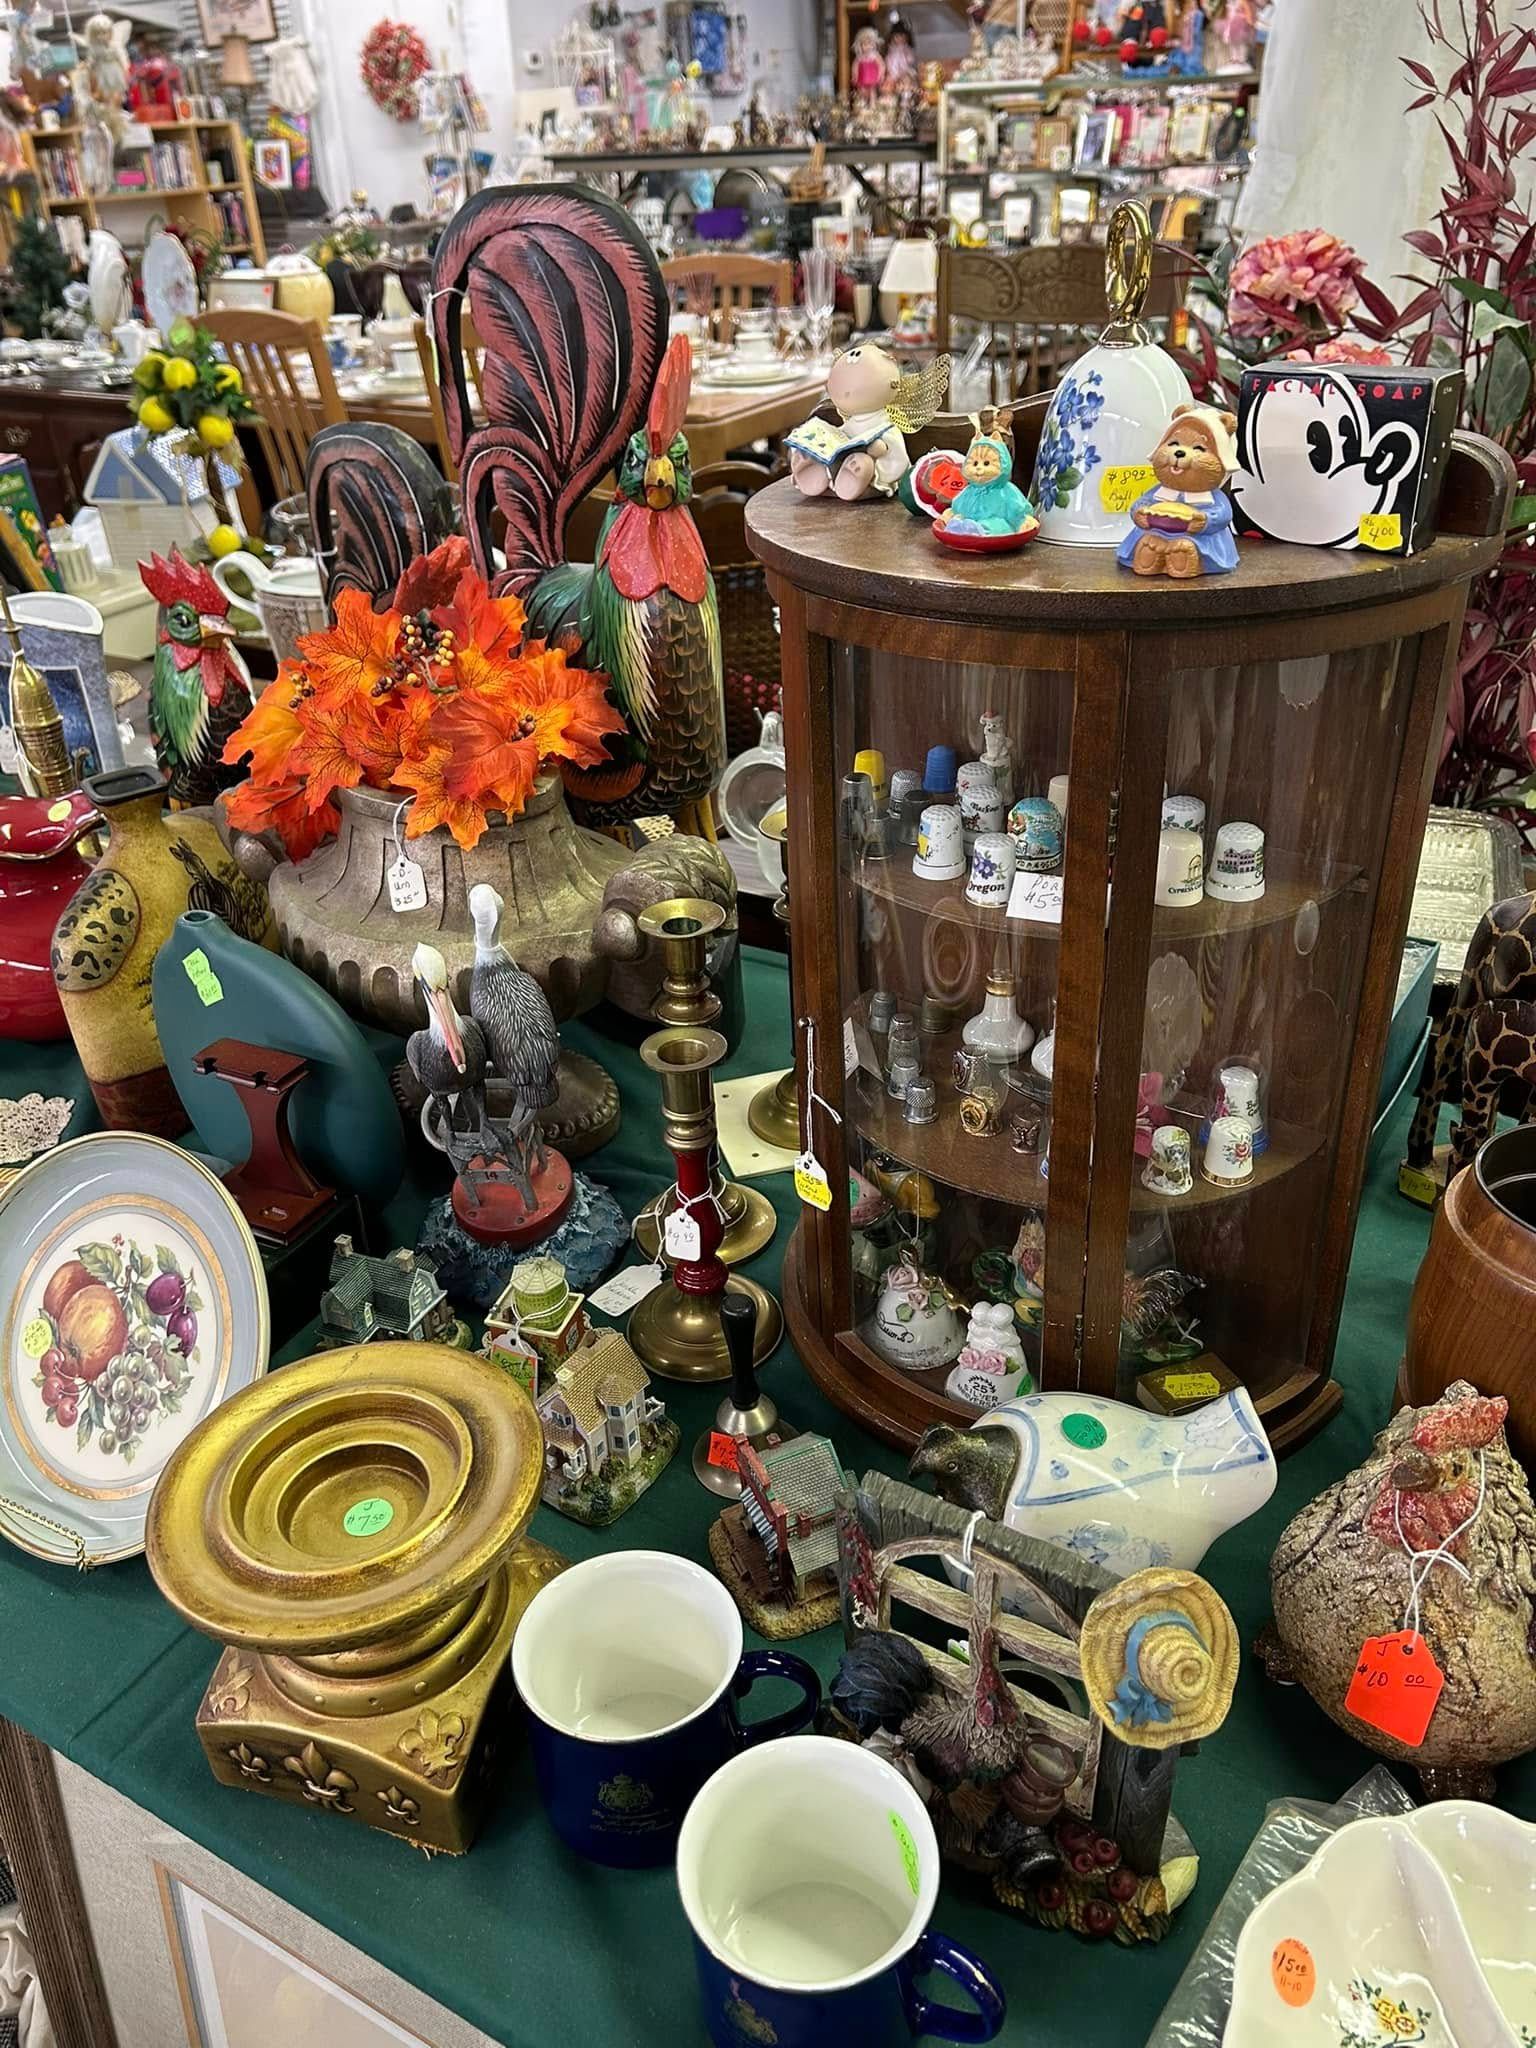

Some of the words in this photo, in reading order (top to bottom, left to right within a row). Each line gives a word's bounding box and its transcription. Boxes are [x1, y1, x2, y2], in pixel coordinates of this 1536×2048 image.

[1251, 378, 1336, 396] FACIAL
[1356, 384, 1423, 400] SOAP
[972, 1381, 989, 1394] 25
